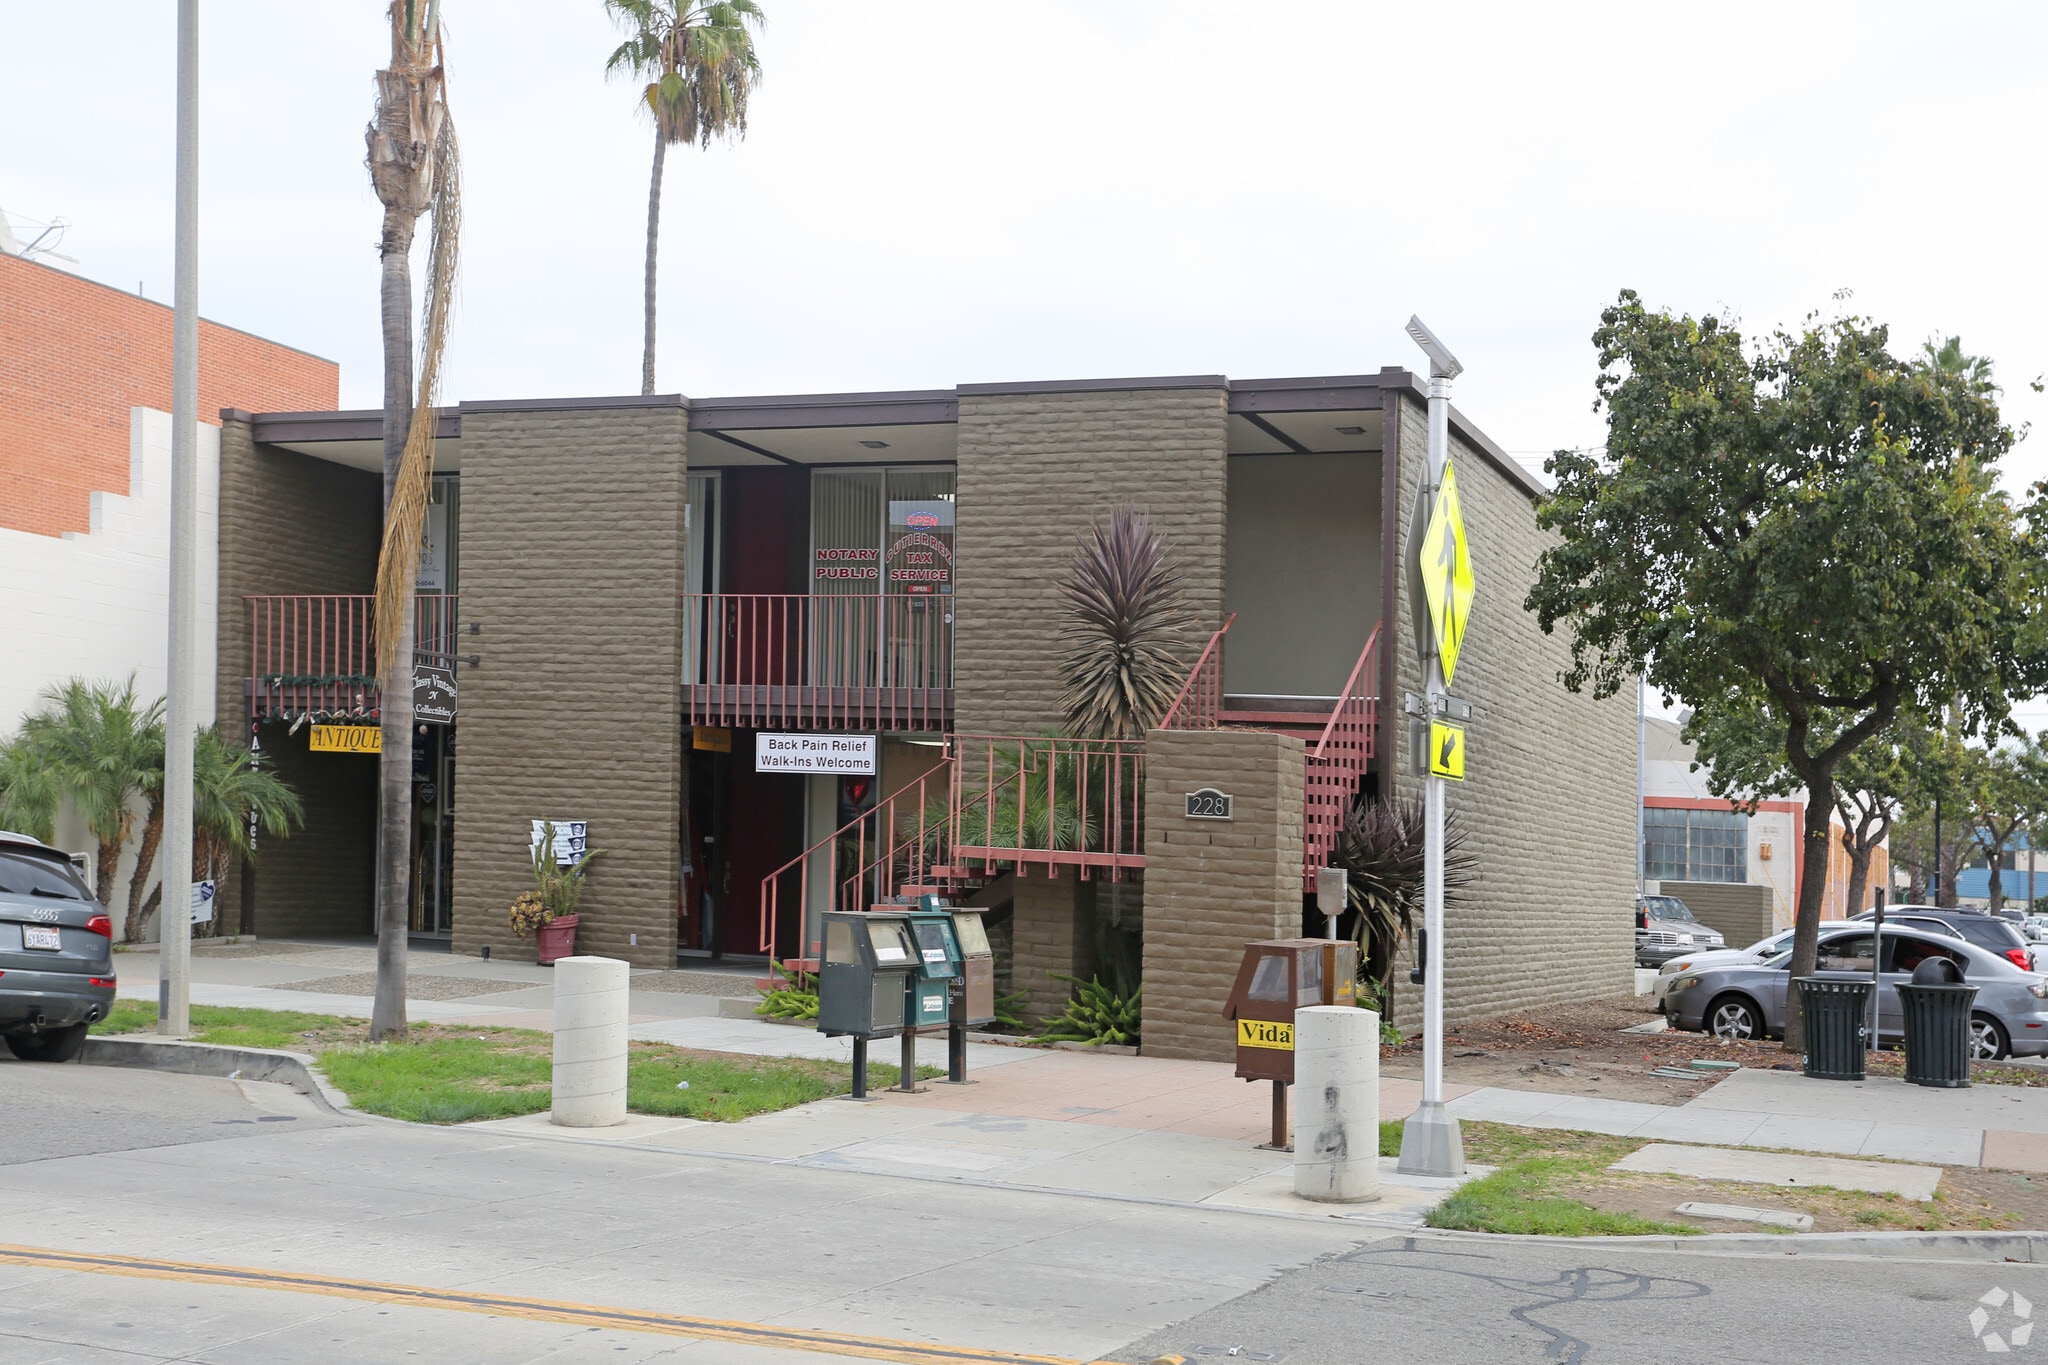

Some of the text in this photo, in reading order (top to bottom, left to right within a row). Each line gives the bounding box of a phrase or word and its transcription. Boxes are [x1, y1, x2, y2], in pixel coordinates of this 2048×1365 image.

[907, 515, 938, 527] OPEN
[817, 549, 879, 560] NOTARY
[886, 533, 952, 566] GUTIERREZ
[906, 552, 933, 564] TAX
[816, 567, 878, 579] PUBLIC
[891, 569, 948, 581] SERVICE
[432, 674, 457, 698] Vintage
[415, 703, 452, 716] Collectibles
[312, 727, 382, 751] ANTIQUE
[769, 739, 867, 752] Back Pain Relief
[761, 755, 871, 769] Walk-Ins Welcome
[1192, 796, 1225, 815] 228
[1242, 1022, 1291, 1044] Vida
